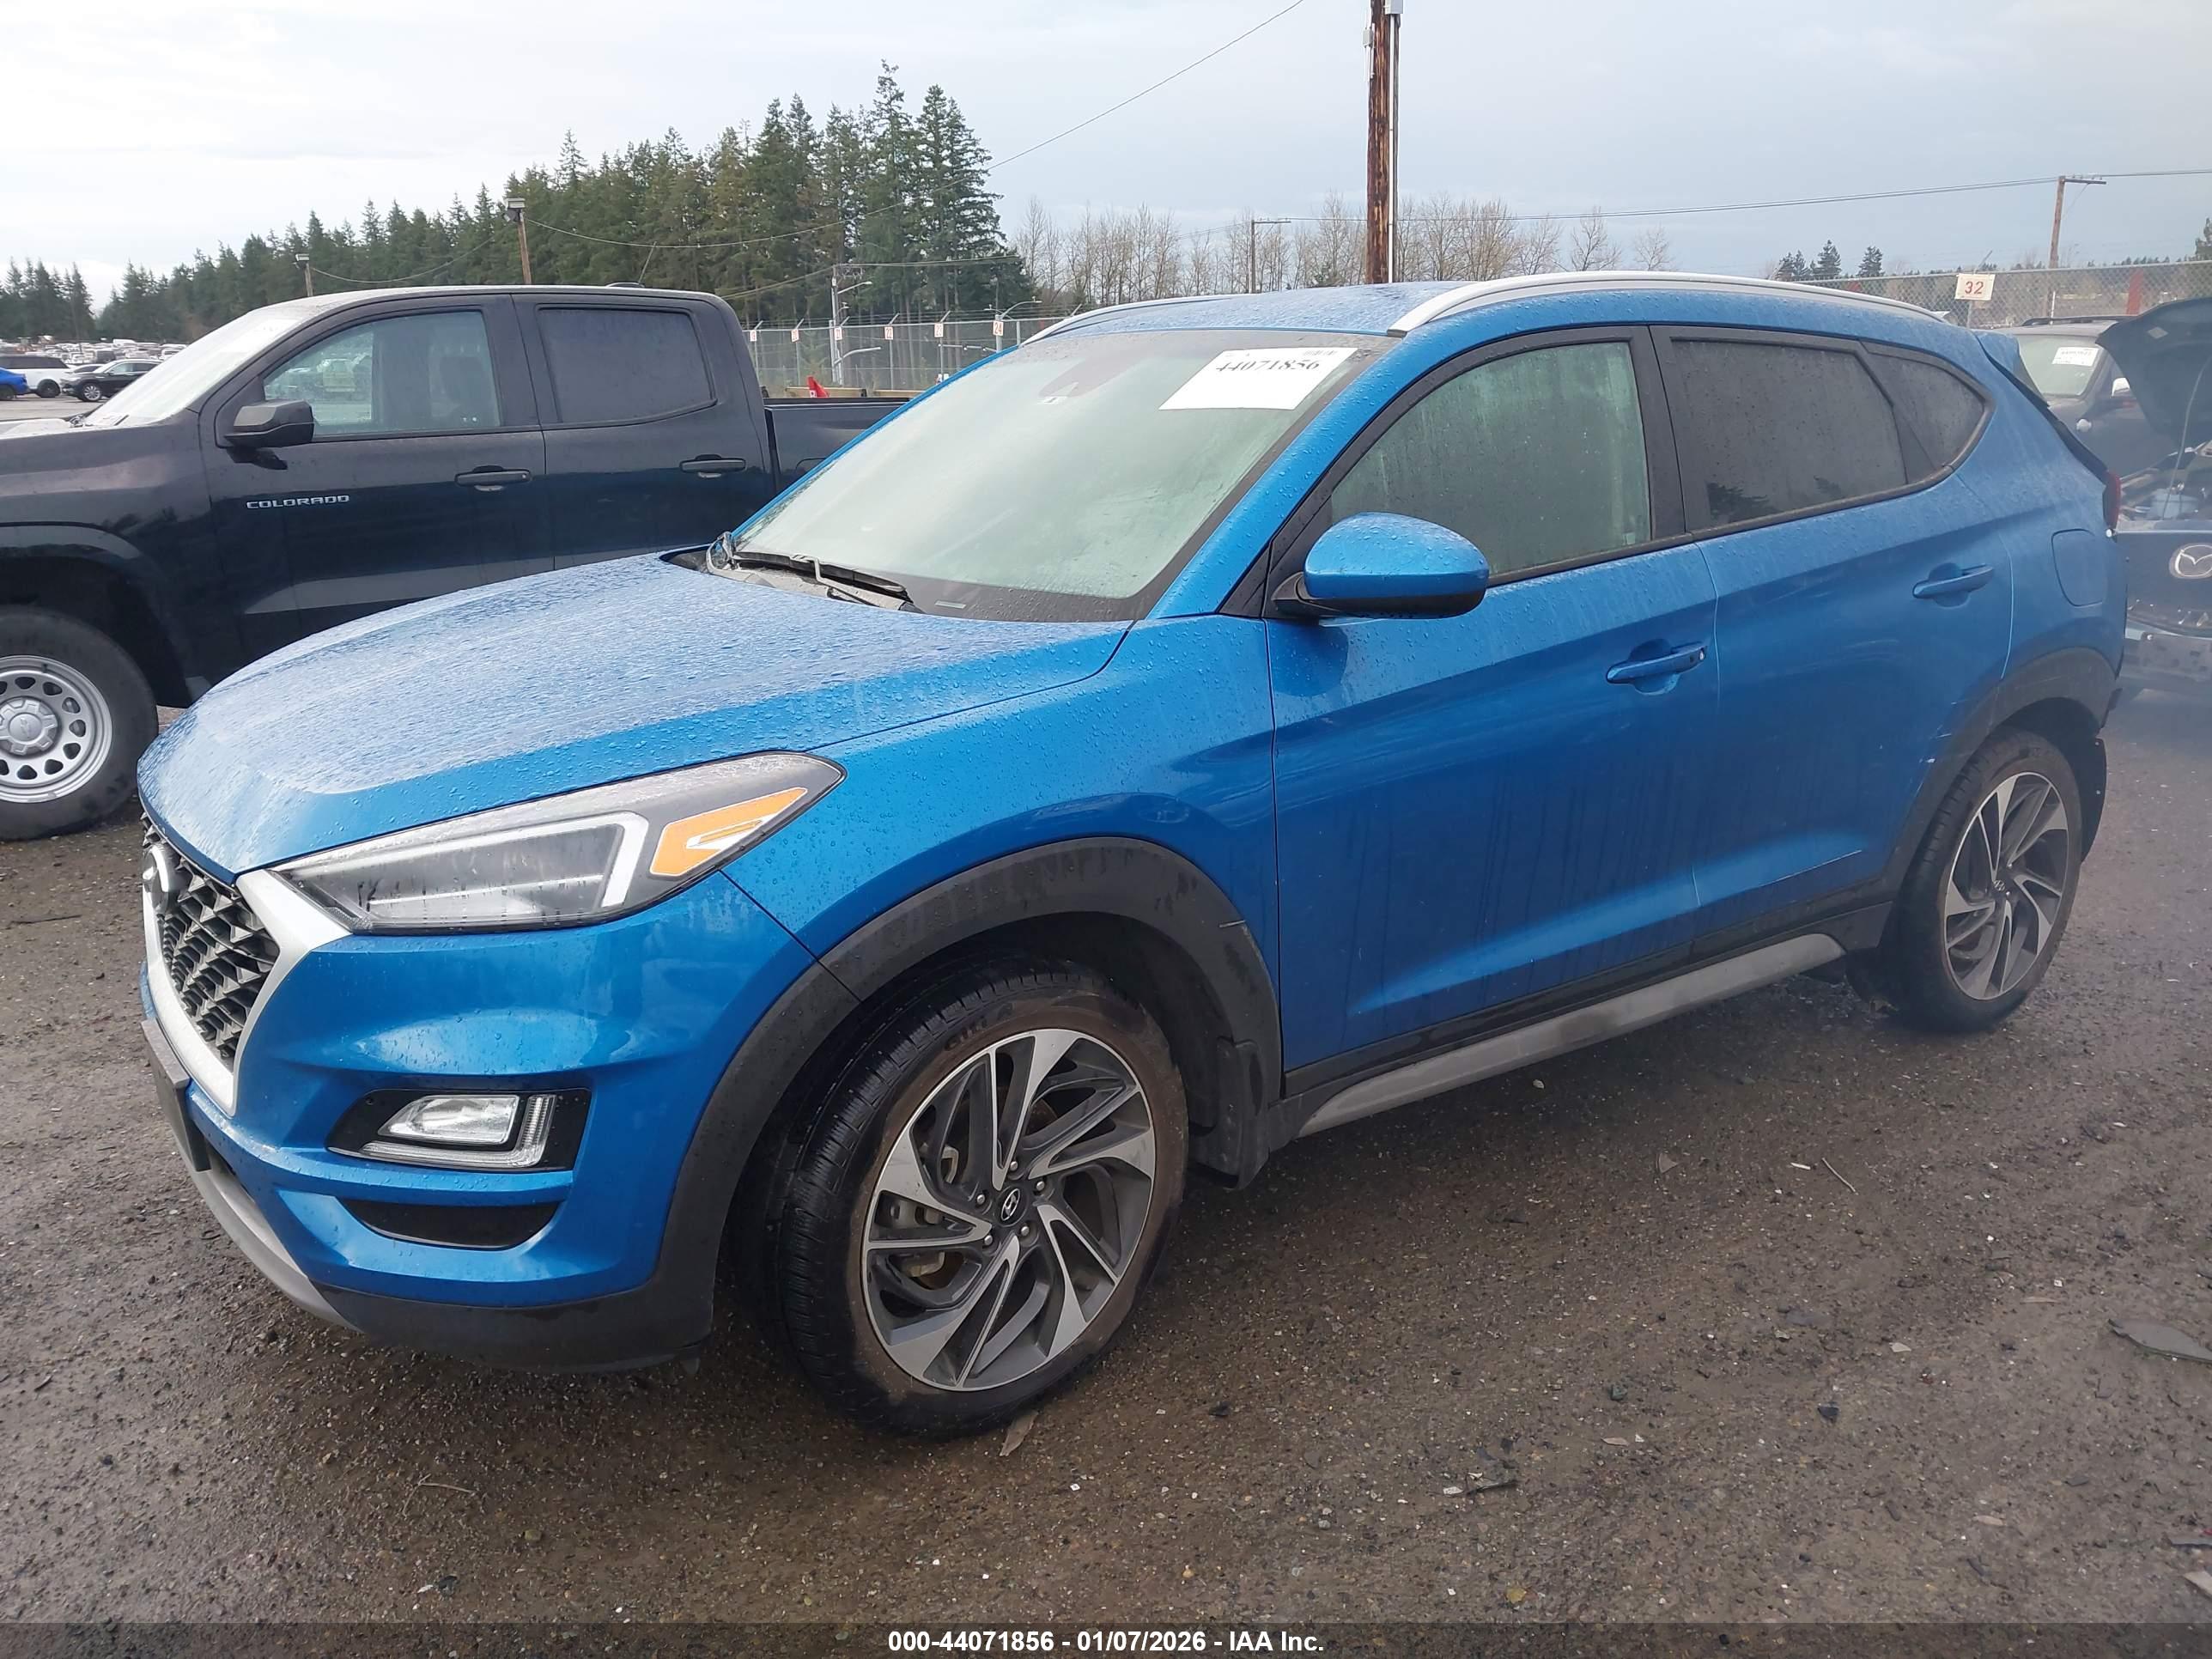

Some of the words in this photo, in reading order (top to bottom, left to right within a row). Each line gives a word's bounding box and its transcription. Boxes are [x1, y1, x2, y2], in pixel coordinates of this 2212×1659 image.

[1965, 281, 1984, 295] 32
[994, 322, 1003, 334] 24
[1215, 359, 1321, 372] 44071856
[246, 495, 350, 509] COLORADO
